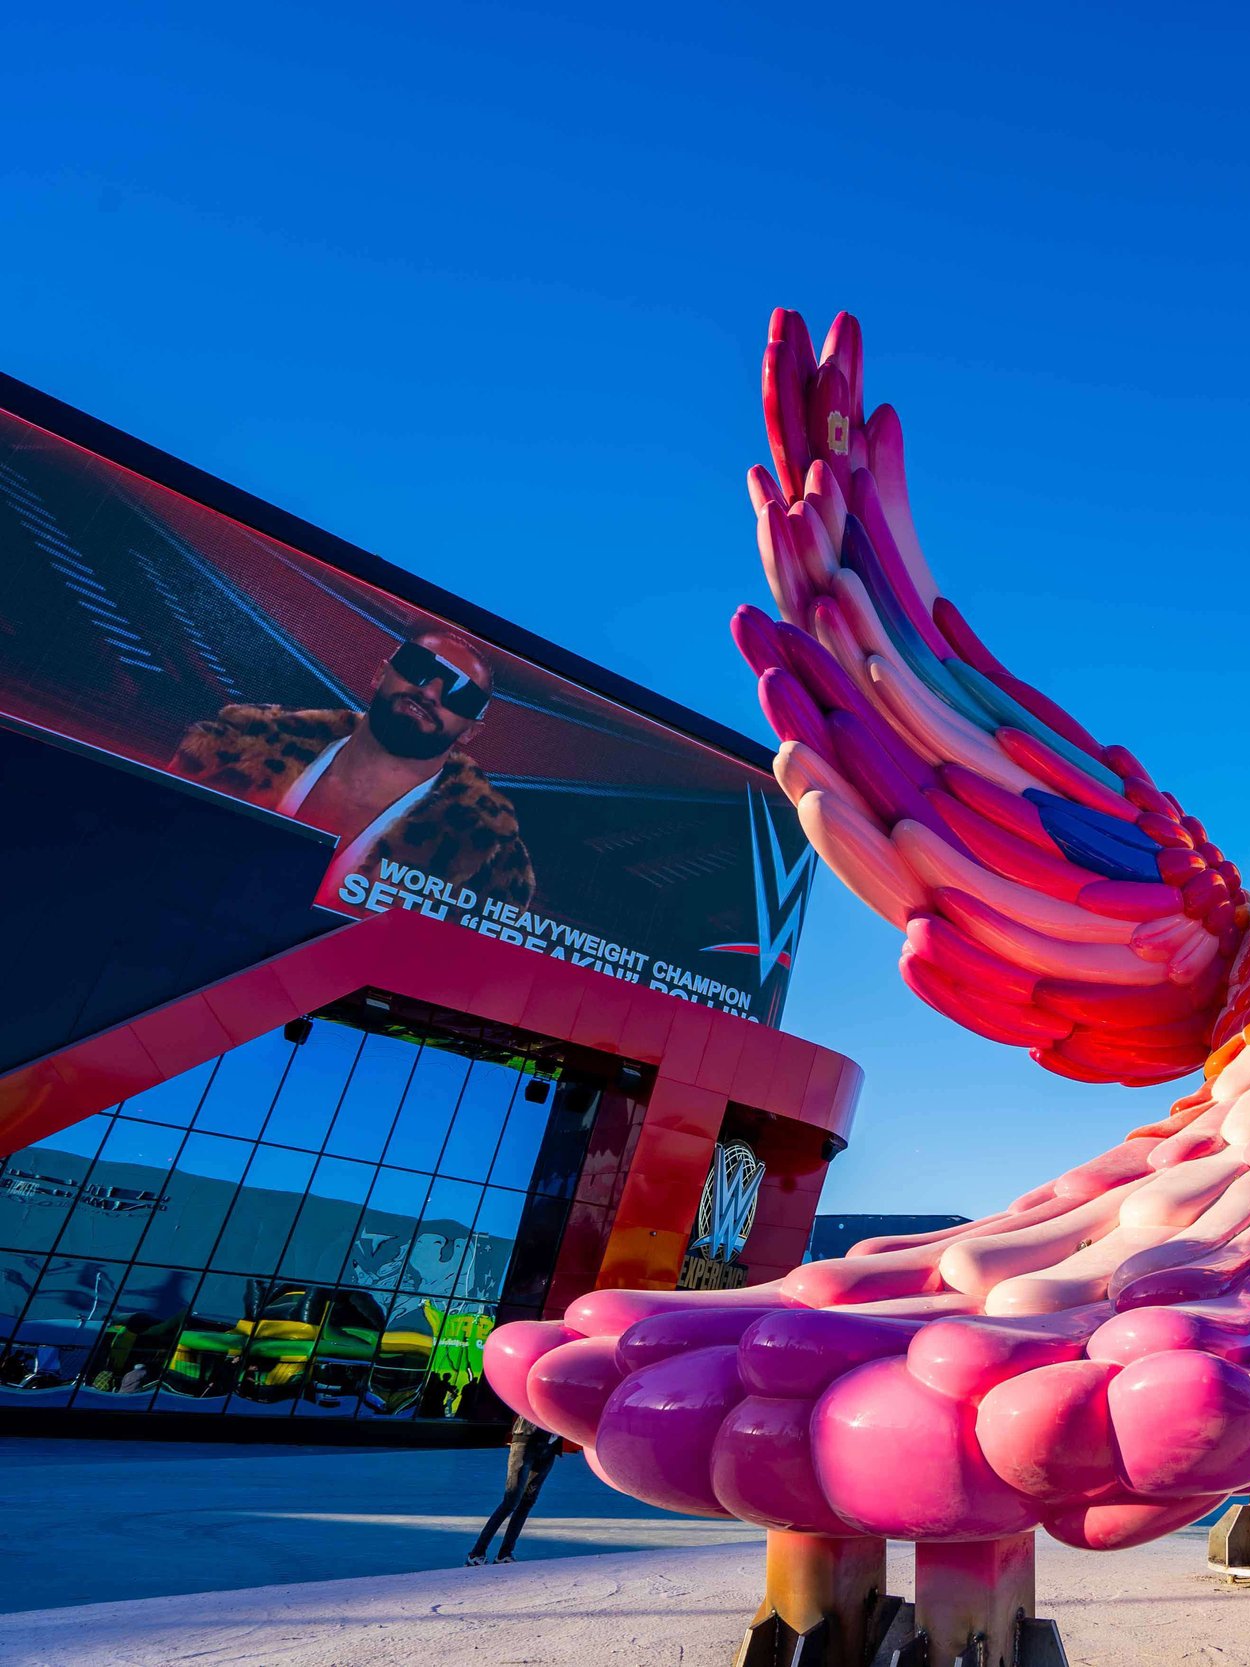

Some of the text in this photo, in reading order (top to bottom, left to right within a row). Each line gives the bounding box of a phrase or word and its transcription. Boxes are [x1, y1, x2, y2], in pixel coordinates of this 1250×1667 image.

[338, 873, 449, 922] SETH
[380, 858, 477, 909] WORLD
[483, 897, 649, 971] HEAVYWEIGHT
[653, 961, 752, 1010] CHAMPION
